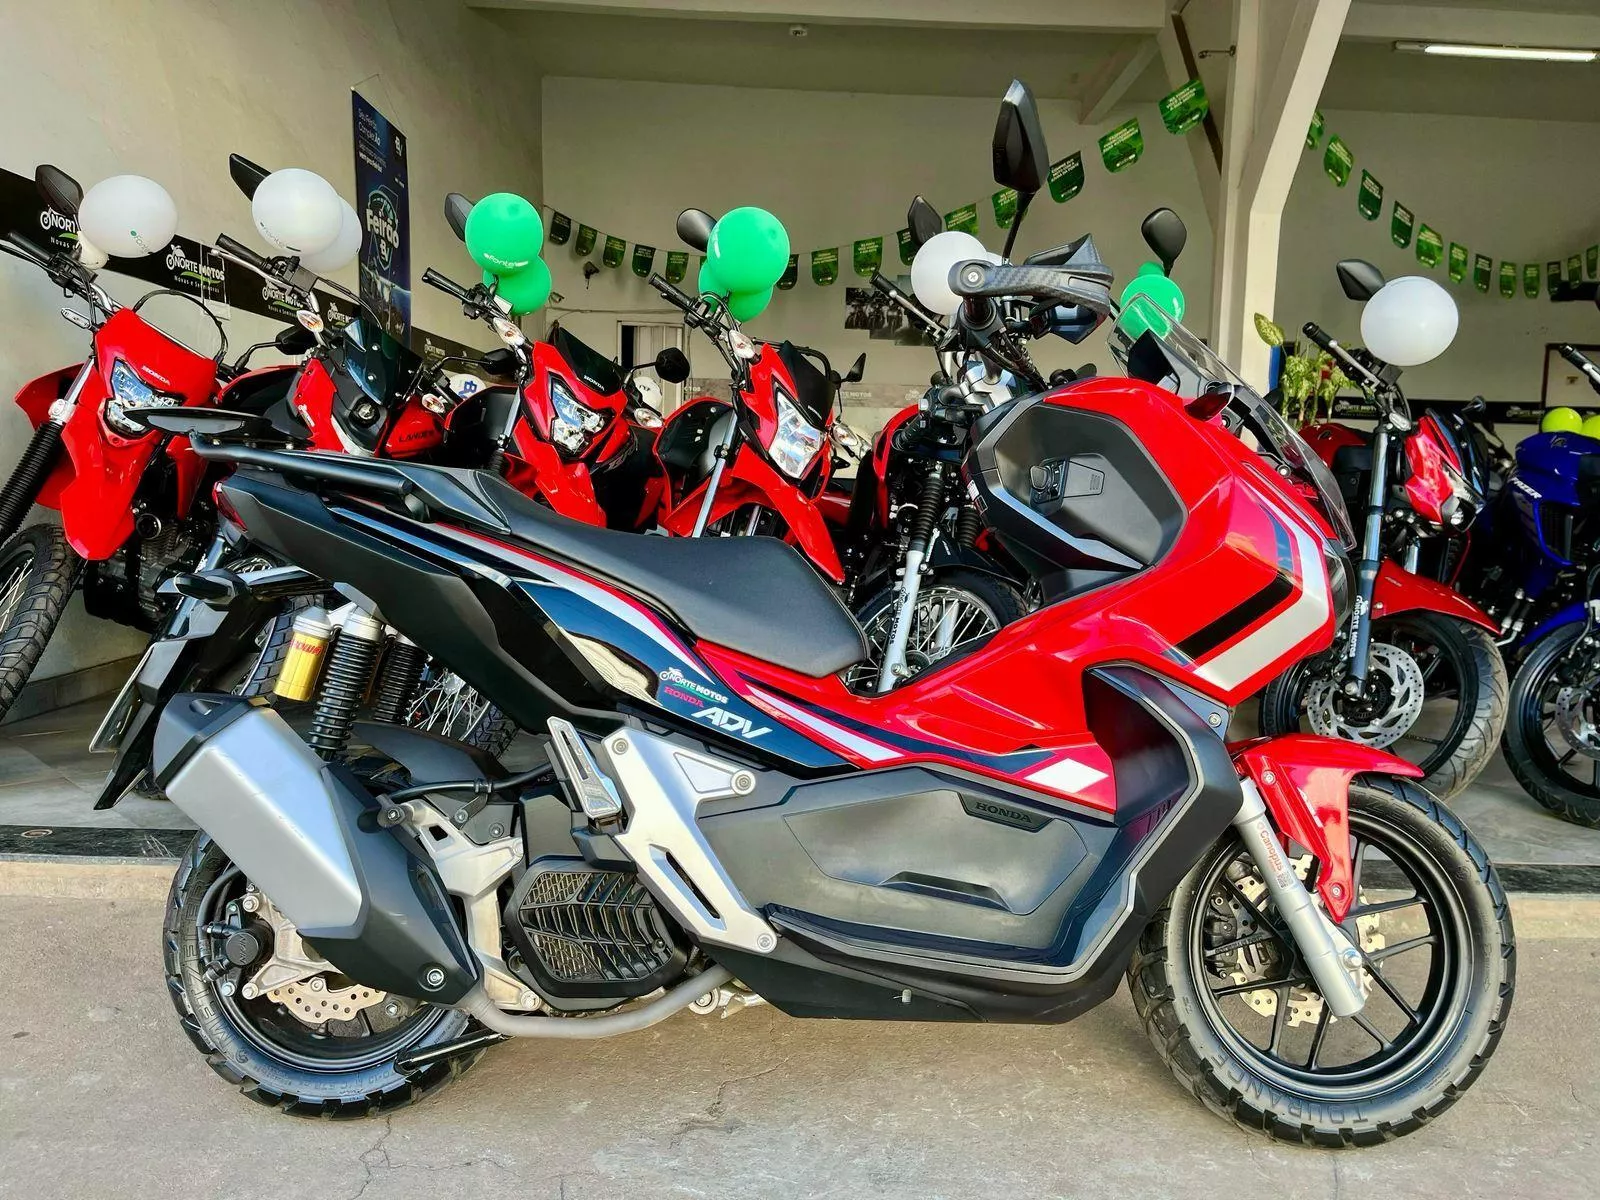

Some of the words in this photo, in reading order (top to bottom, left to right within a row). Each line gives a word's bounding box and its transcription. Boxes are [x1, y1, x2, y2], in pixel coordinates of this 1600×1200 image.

[51, 213, 76, 234] NORT
[366, 208, 399, 249] Feirão
[174, 256, 198, 274] NORTE
[198, 263, 225, 281] MOTOS
[141, 365, 170, 386] HONDA
[583, 374, 605, 391] HONDA
[664, 684, 705, 708] HONDA
[669, 672, 696, 690] NORTE
[695, 684, 729, 705] MOTOS
[691, 706, 773, 739] ADV
[974, 801, 1033, 824] HONDA
[1210, 1053, 1369, 1125] TOURANCE
